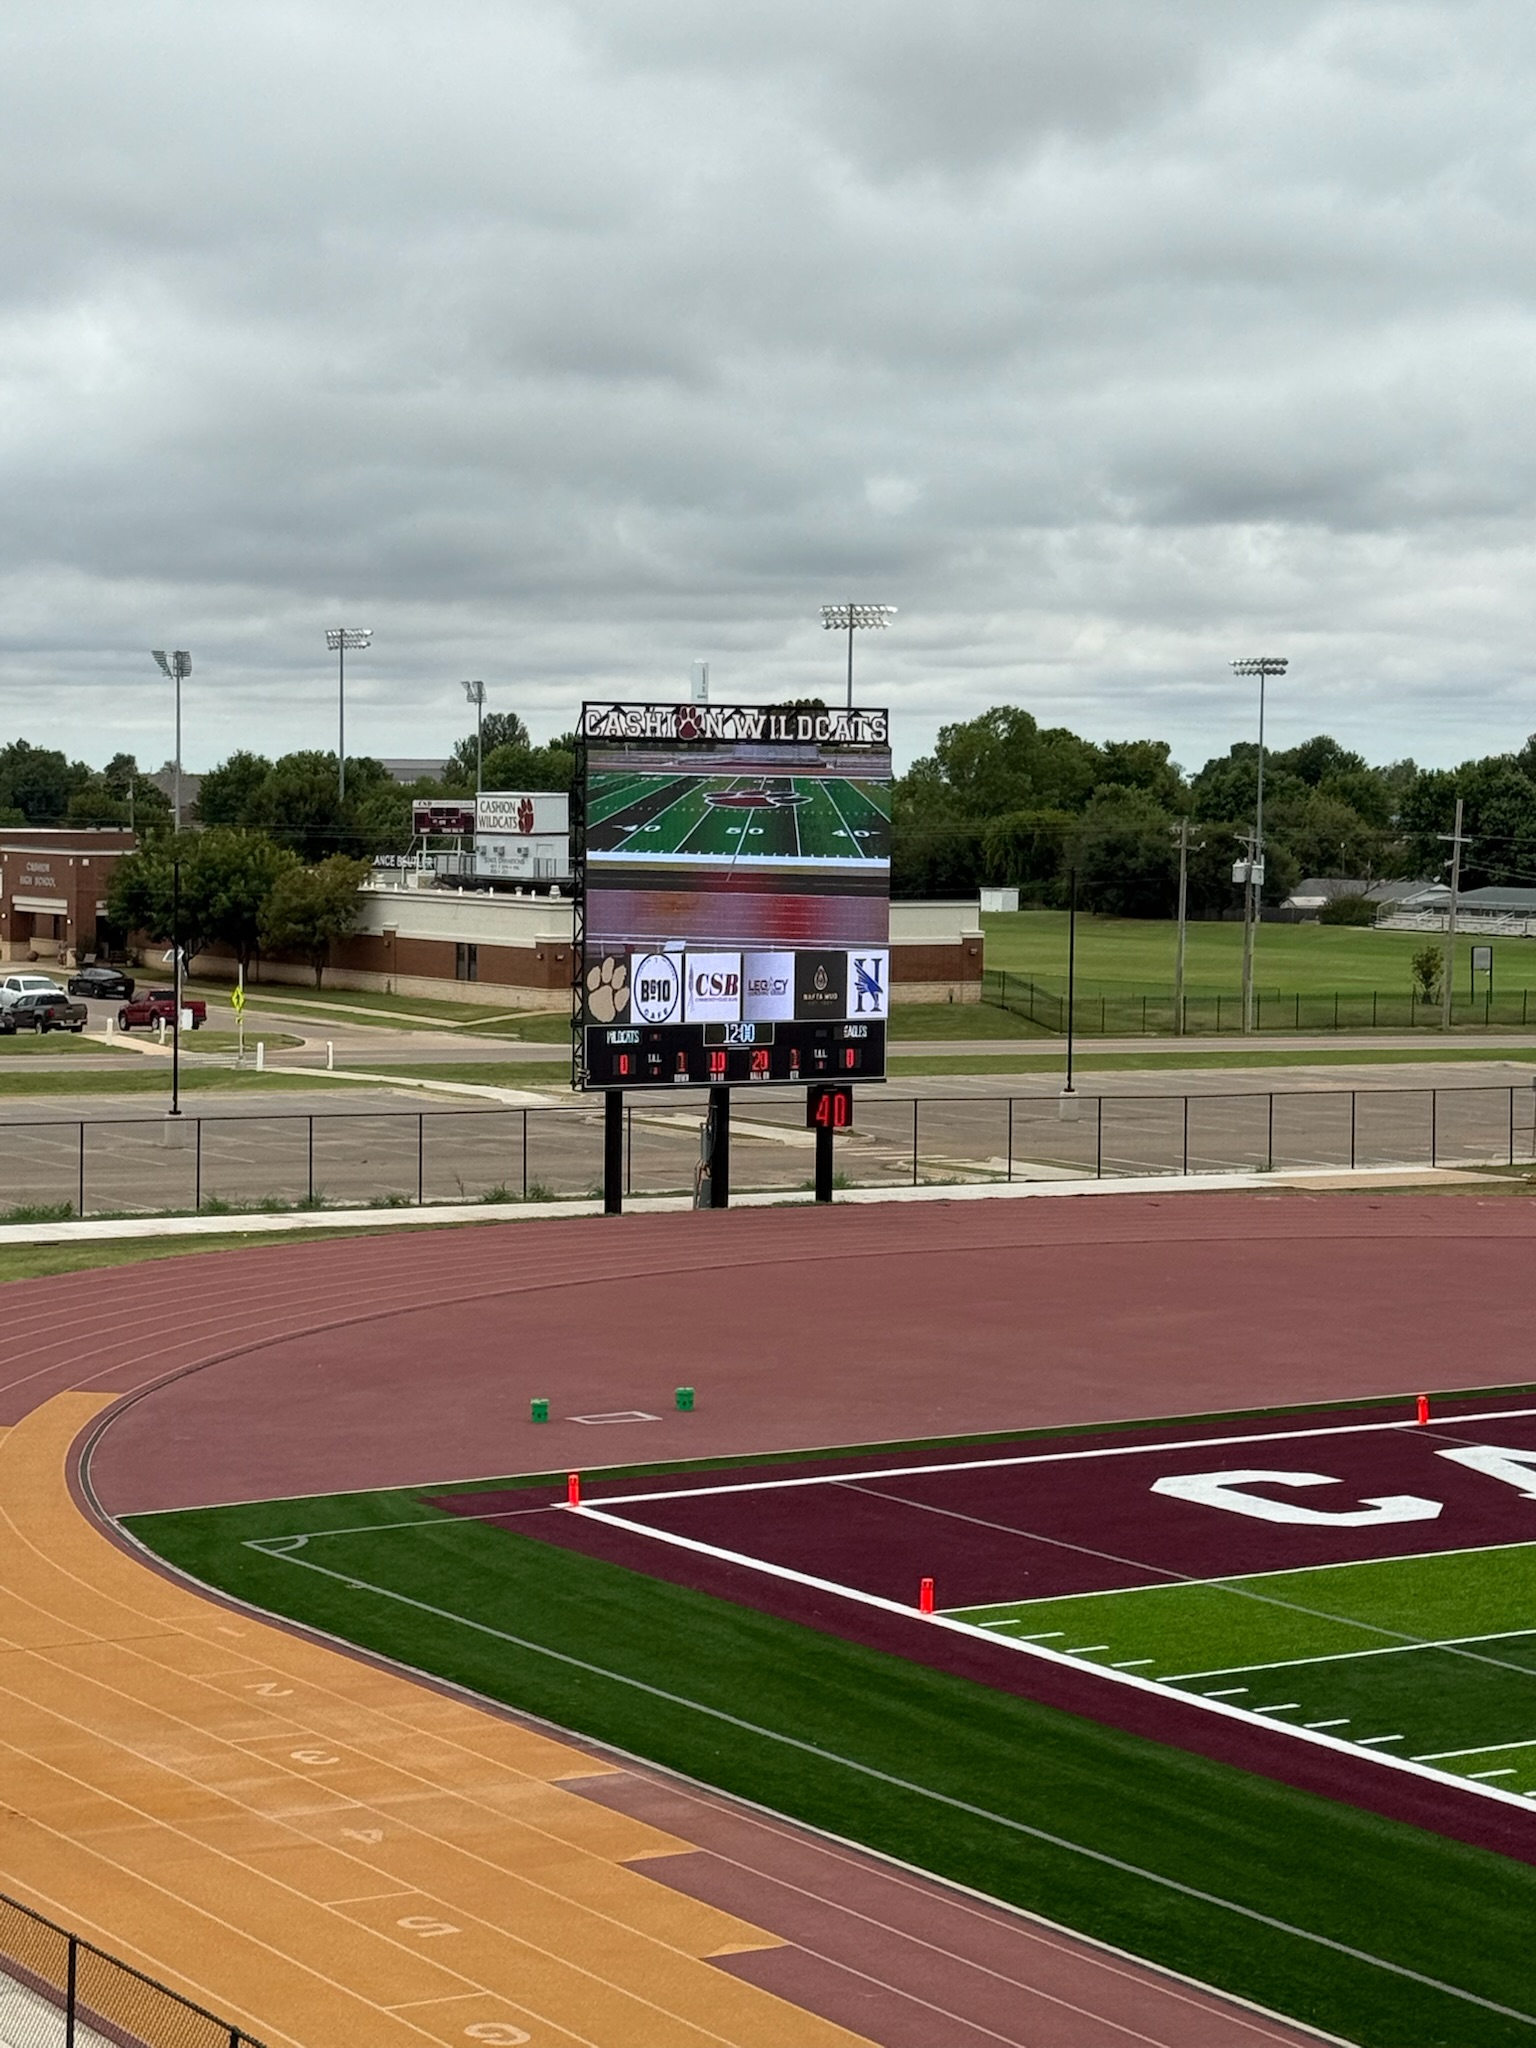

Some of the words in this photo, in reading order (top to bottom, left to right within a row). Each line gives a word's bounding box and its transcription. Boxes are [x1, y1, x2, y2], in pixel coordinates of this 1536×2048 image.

[585, 706, 724, 740] CASHIN
[731, 713, 887, 743] WILDCATS
[480, 800, 516, 814] CASHION
[478, 815, 518, 829] WILDCATS
[725, 827, 765, 836] 50
[371, 854, 396, 867] ANCE
[34, 876, 56, 888] SCHOOL
[695, 973, 739, 997] CSB
[723, 1023, 755, 1043] 12:00
[843, 1025, 868, 1038] EAGLES
[619, 1054, 629, 1075] 0
[709, 1051, 726, 1072] 10
[752, 1050, 768, 1070] 20
[845, 1048, 854, 1069] 0
[816, 1093, 846, 1127] 40
[245, 1682, 294, 1697] 2
[290, 1749, 340, 1765] 3
[340, 1827, 384, 1845] 4
[396, 1915, 463, 1939] 5
[463, 2021, 532, 2047] 6
